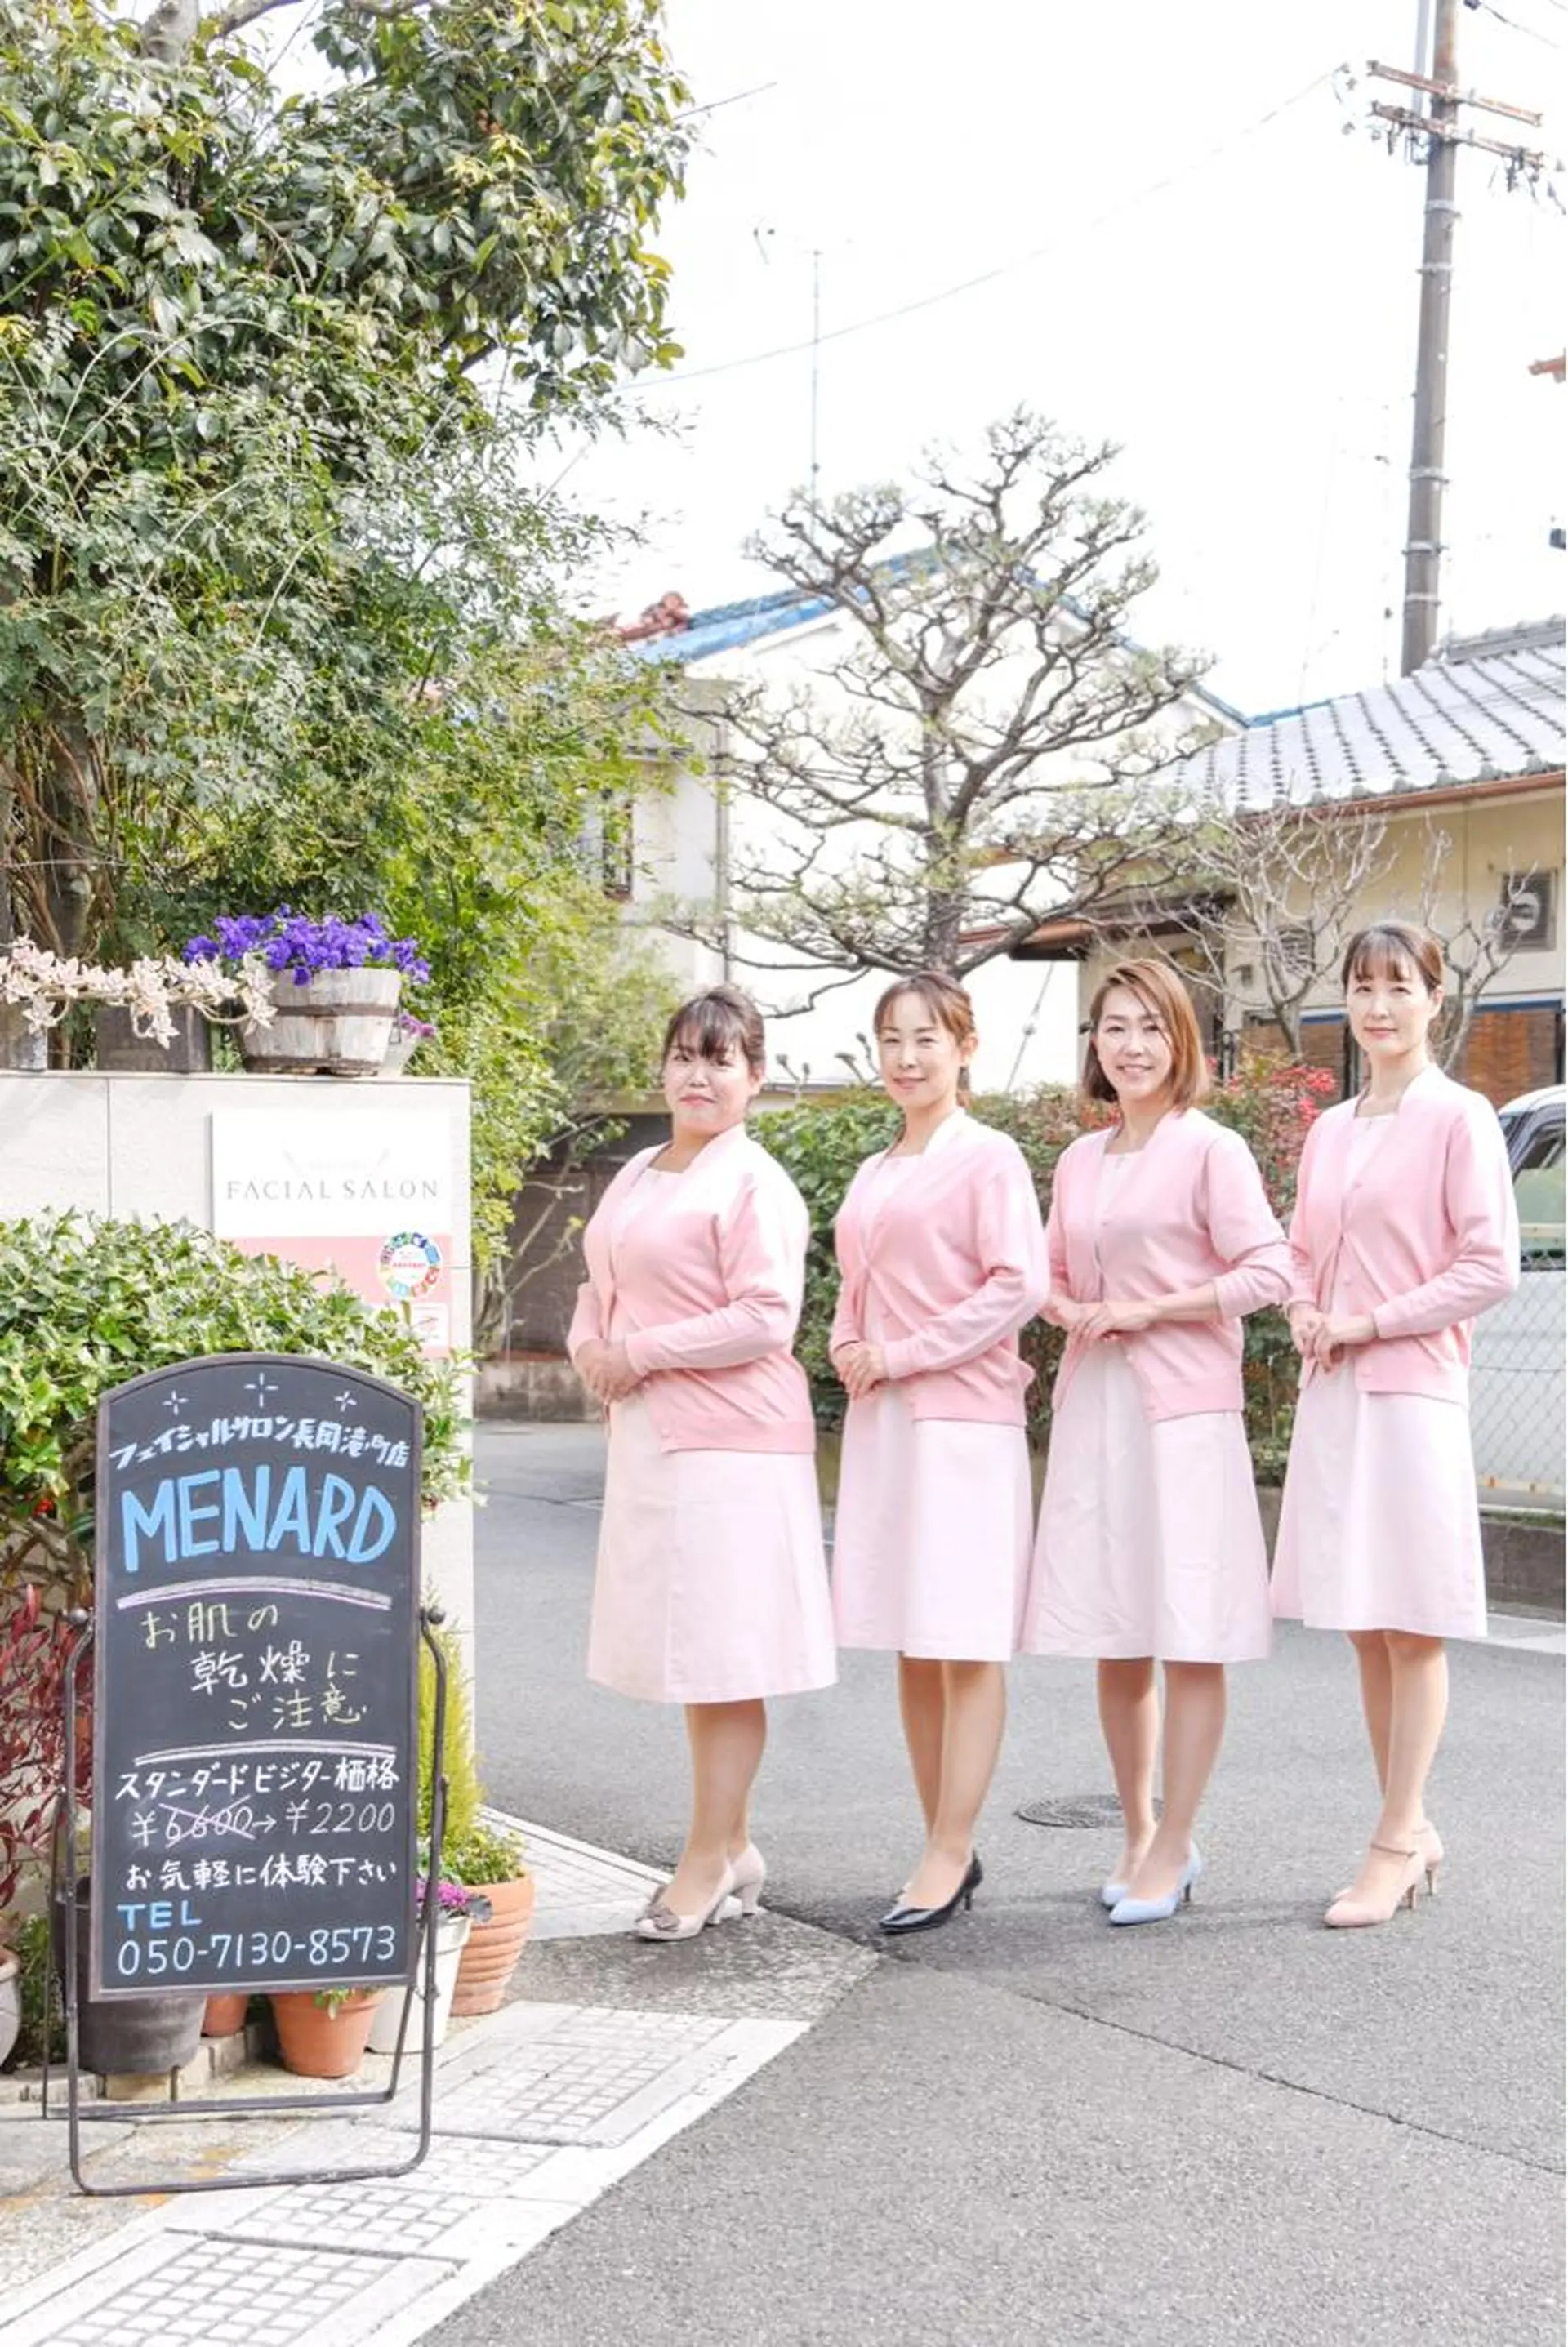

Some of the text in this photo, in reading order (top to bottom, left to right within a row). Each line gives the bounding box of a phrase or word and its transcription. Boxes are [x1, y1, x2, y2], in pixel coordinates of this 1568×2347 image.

[226, 1179, 439, 1200] FACIAL SALON
[122, 1465, 397, 1573] MENARD
[141, 1602, 278, 1649] お肌の
[189, 1640, 361, 1695] 乾燥に
[229, 1682, 368, 1730] ご注意
[127, 1853, 397, 1891] お気軽に体験下さい
[116, 1900, 203, 1931] TEL
[118, 1926, 396, 1975] 050-7130-8573
